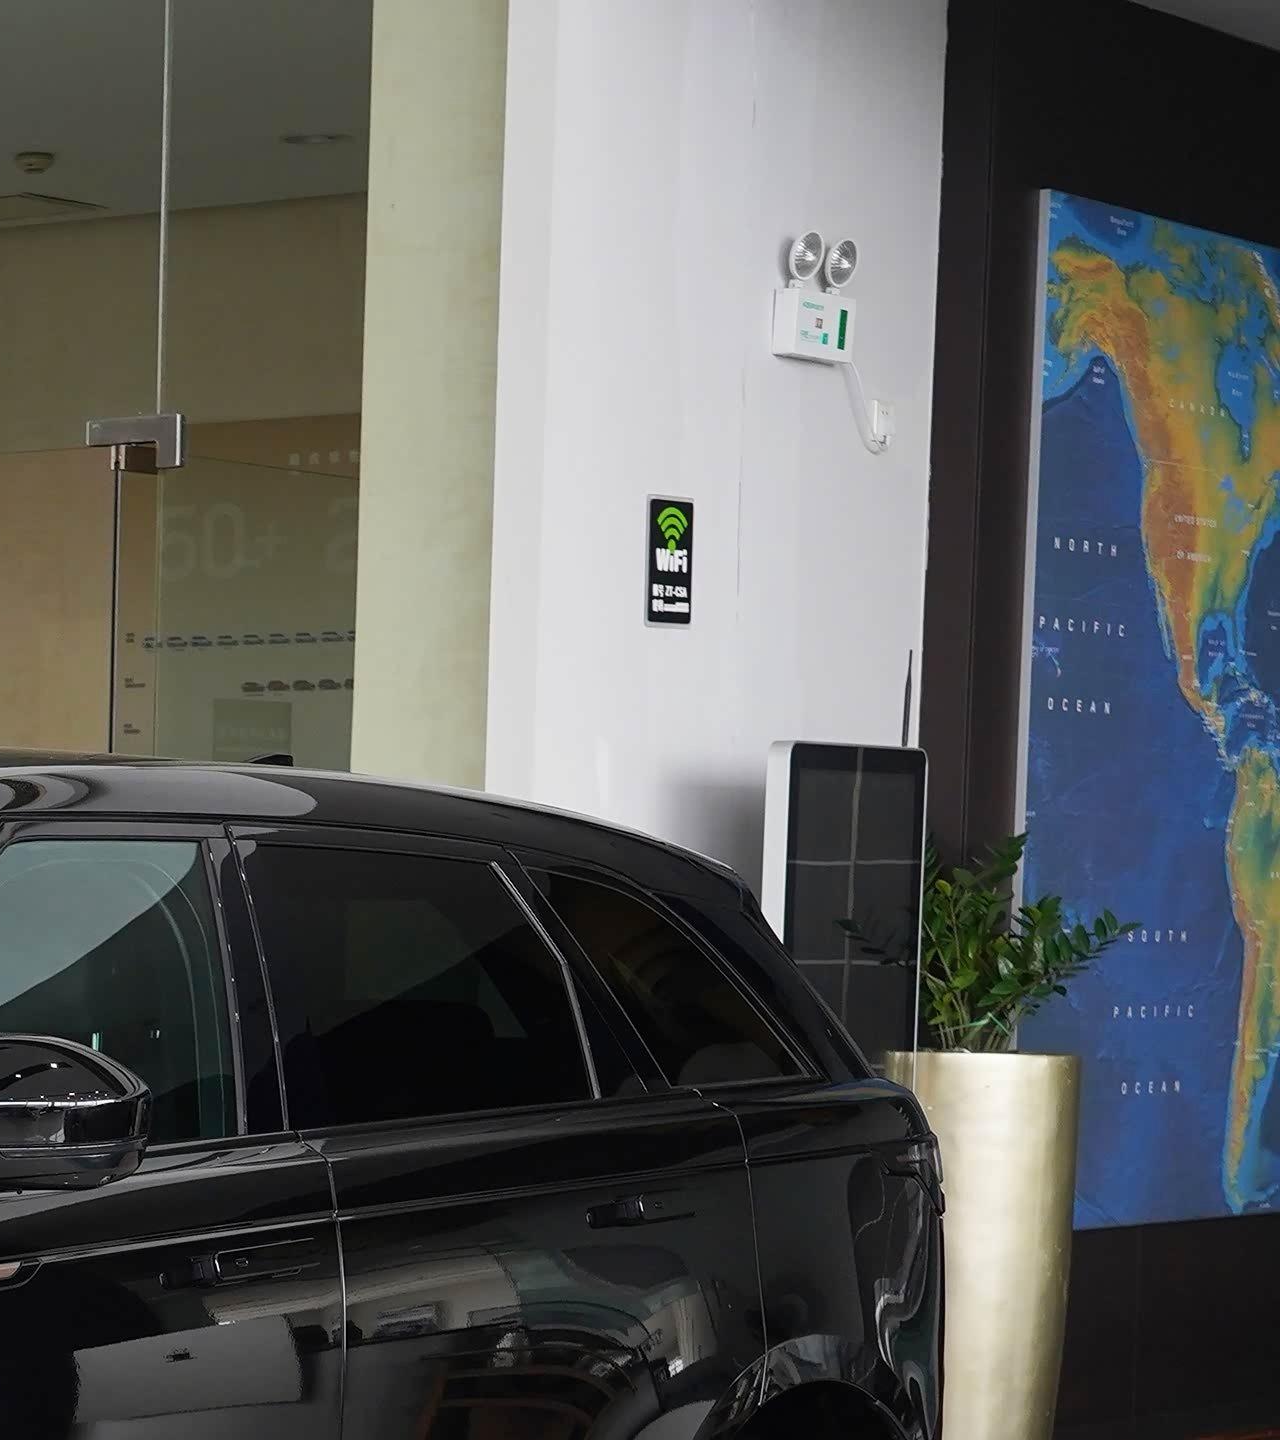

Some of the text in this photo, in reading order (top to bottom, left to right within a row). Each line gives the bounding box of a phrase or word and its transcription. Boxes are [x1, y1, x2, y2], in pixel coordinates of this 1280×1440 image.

[1054, 537, 1119, 557] NORTH
[1039, 615, 1127, 638] PACIFIC
[1047, 697, 1111, 715] OCEAN
[1127, 929, 1188, 944] SOUTH
[1112, 1004, 1194, 1020] PACIFIC
[1120, 1079, 1181, 1096] OCEAN
